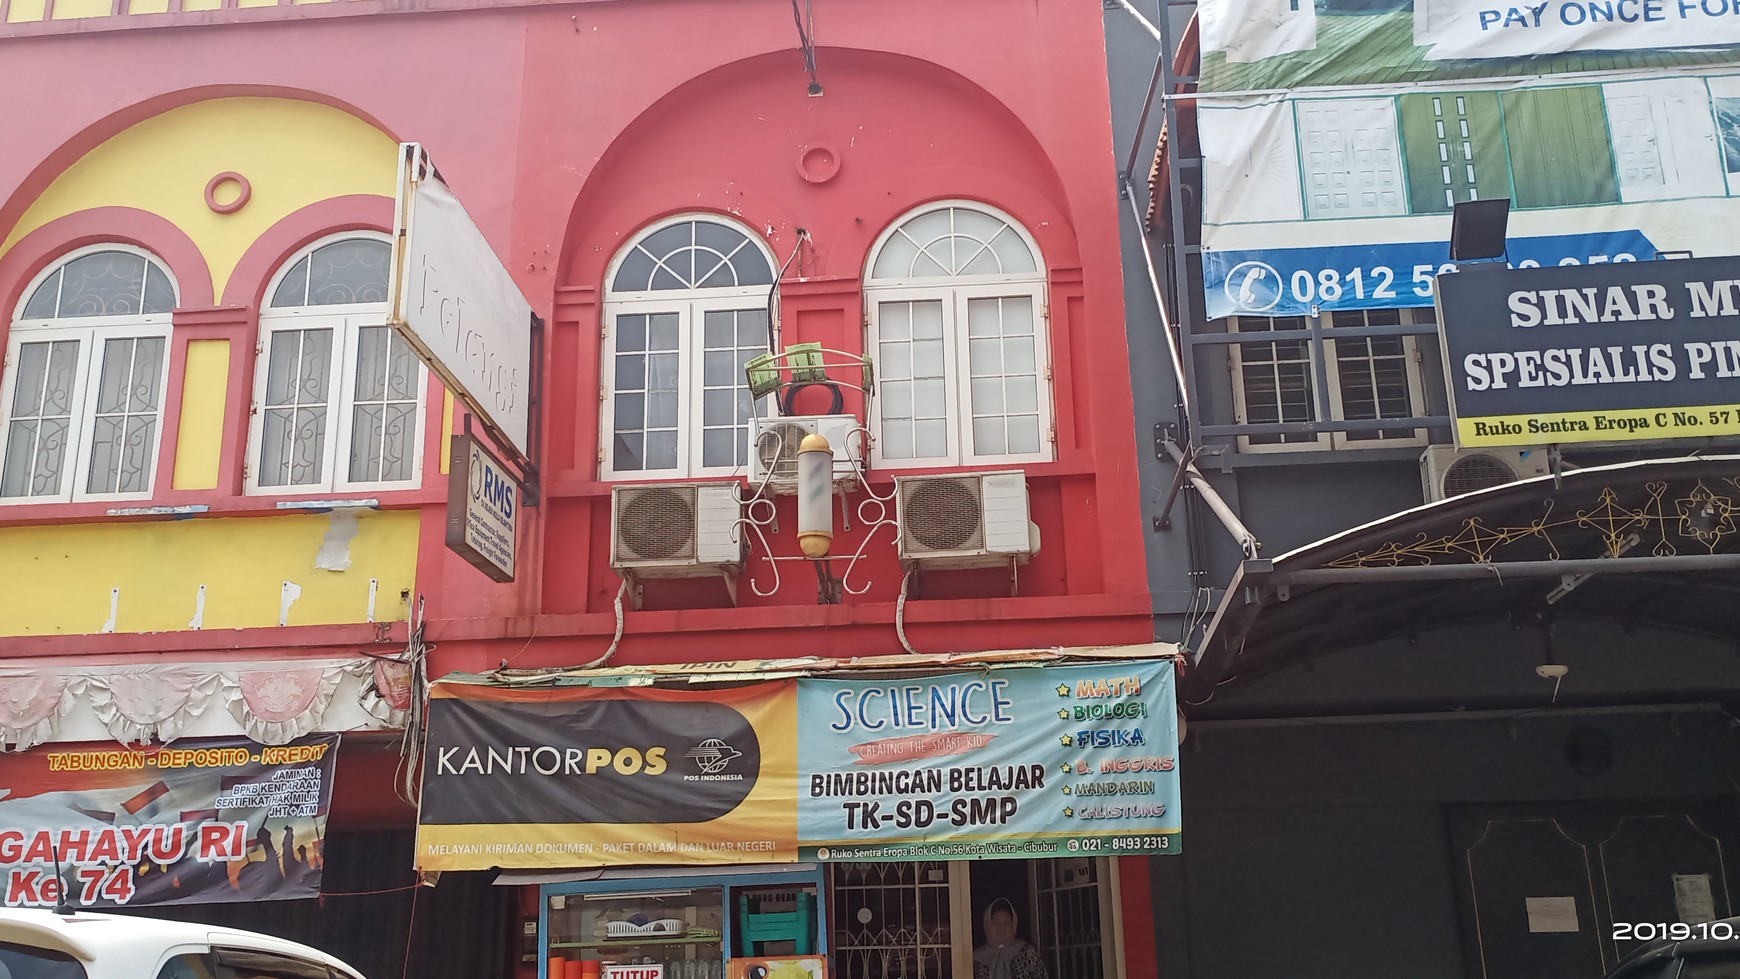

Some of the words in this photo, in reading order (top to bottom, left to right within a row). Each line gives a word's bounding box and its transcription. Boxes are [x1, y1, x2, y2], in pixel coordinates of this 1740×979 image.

[1479, 1, 1548, 30] PAY
[1559, 0, 1665, 26] ONCE
[1291, 266, 1396, 302] 0812
[1507, 284, 1675, 328] SINAR
[1684, 280, 1740, 318] M
[1464, 343, 1677, 391] SPESIALIS
[1474, 420, 1523, 437] Ruko
[1527, 418, 1589, 434] Sentra
[1594, 414, 1650, 434] Eropa
[1654, 412, 1668, 428] C
[1673, 411, 1703, 427] No.
[1709, 410, 1730, 425] 57
[484, 464, 513, 519] RMS
[1076, 675, 1141, 698] MATH
[831, 680, 1013, 731] SCIENCE
[1073, 702, 1147, 721] BIOLOGI
[859, 742, 904, 758] CREATING
[909, 739, 926, 752] THE
[932, 736, 961, 751] SMART
[966, 734, 983, 748] KID
[1076, 728, 1145, 747] FISIKA
[48, 752, 144, 771] TABUNGAN
[158, 748, 249, 768] DEPOSITO
[261, 744, 328, 765] KREDIT
[437, 746, 669, 776] KANTORPOS
[1075, 760, 1092, 774] B.
[1100, 756, 1175, 773] INGGRIS
[272, 768, 315, 782] JAMINAN
[810, 768, 943, 798] BIMBINGAN
[949, 764, 1045, 794] BELAJAR
[232, 784, 259, 795] BPKB
[259, 780, 320, 794] KENDARAAN
[1074, 781, 1155, 796] MANDARIN
[215, 796, 269, 808] SERTIFIKAT
[271, 794, 292, 806] HAK
[292, 792, 319, 804] MILIK
[268, 806, 288, 818] JHT
[297, 805, 317, 816] ATM
[1077, 803, 1165, 819] CALISTUNG
[842, 796, 1018, 830] TK-SD-SMP
[199, 824, 246, 861] RI
[428, 845, 482, 855] MELAYANI
[485, 844, 533, 854] KIRIMAN
[535, 843, 593, 854] DOKUMEN
[602, 842, 635, 853] PAKET
[637, 842, 677, 853] DALAM
[680, 842, 704, 852] DAN
[706, 842, 734, 852] LUAR
[736, 841, 776, 852] NEGERI
[831, 849, 853, 859] Ruko
[854, 848, 881, 858] Sentra
[883, 847, 908, 858] Eropa
[910, 846, 929, 856] Blok
[930, 845, 937, 855] C
[938, 845, 964, 855] No.56
[965, 844, 985, 854] Kota
[986, 843, 1017, 853] Wisata
[1023, 841, 1058, 852] Cibubur
[1081, 839, 1101, 851] 021
[1112, 838, 1141, 850] 8493
[1143, 836, 1169, 849] 2313
[7, 869, 66, 904] Ke
[78, 867, 133, 903] 74
